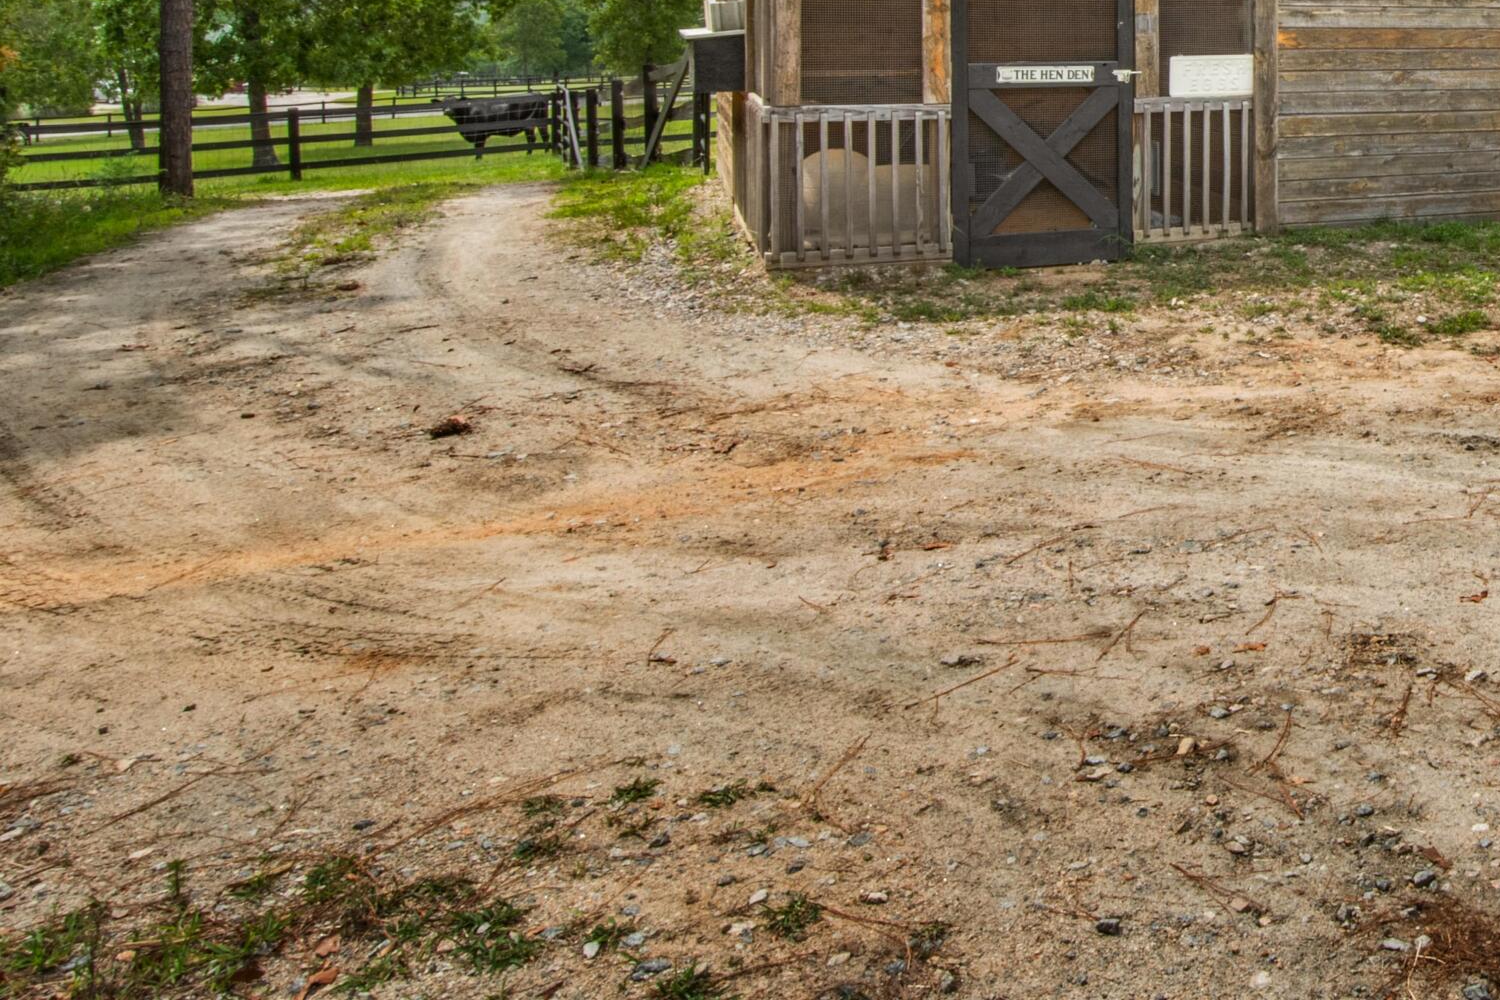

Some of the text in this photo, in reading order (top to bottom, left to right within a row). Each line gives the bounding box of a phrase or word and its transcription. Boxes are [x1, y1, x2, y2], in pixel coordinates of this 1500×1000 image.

[1014, 69, 1089, 80] THE HEN DEN
[1183, 60, 1250, 77] FRESH
[1189, 77, 1240, 93] EGGS
